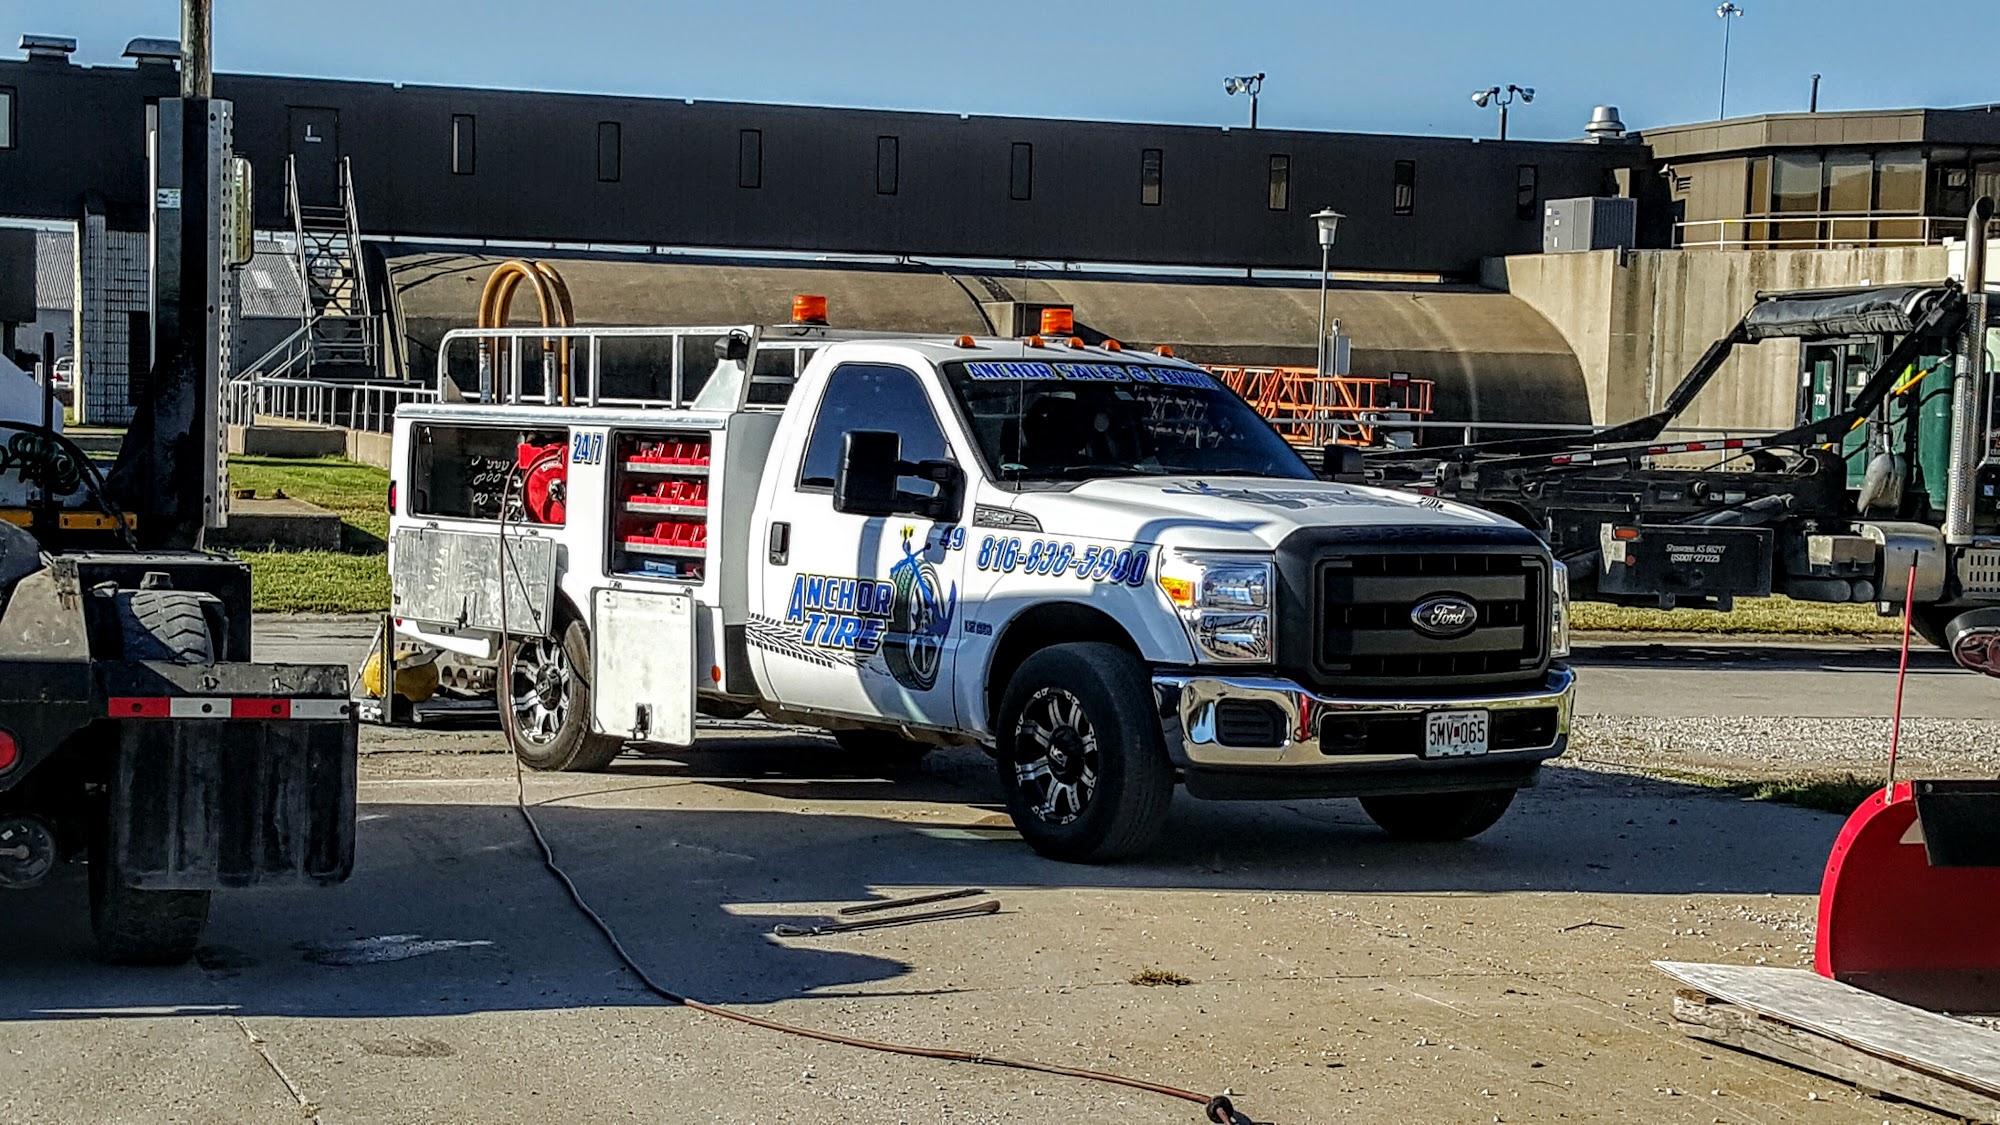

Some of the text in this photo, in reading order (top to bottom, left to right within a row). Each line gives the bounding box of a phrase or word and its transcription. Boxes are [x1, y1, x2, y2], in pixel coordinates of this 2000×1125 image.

[966, 363, 1059, 381] ANCHOR
[1054, 364, 1130, 383] SALES
[1127, 366, 1154, 383] &
[573, 432, 604, 464] 24/7
[785, 574, 895, 625] ANCHOR
[1430, 604, 1466, 625] Ford
[802, 611, 886, 652] TIRE
[1429, 720, 1485, 746] 5MV 065
